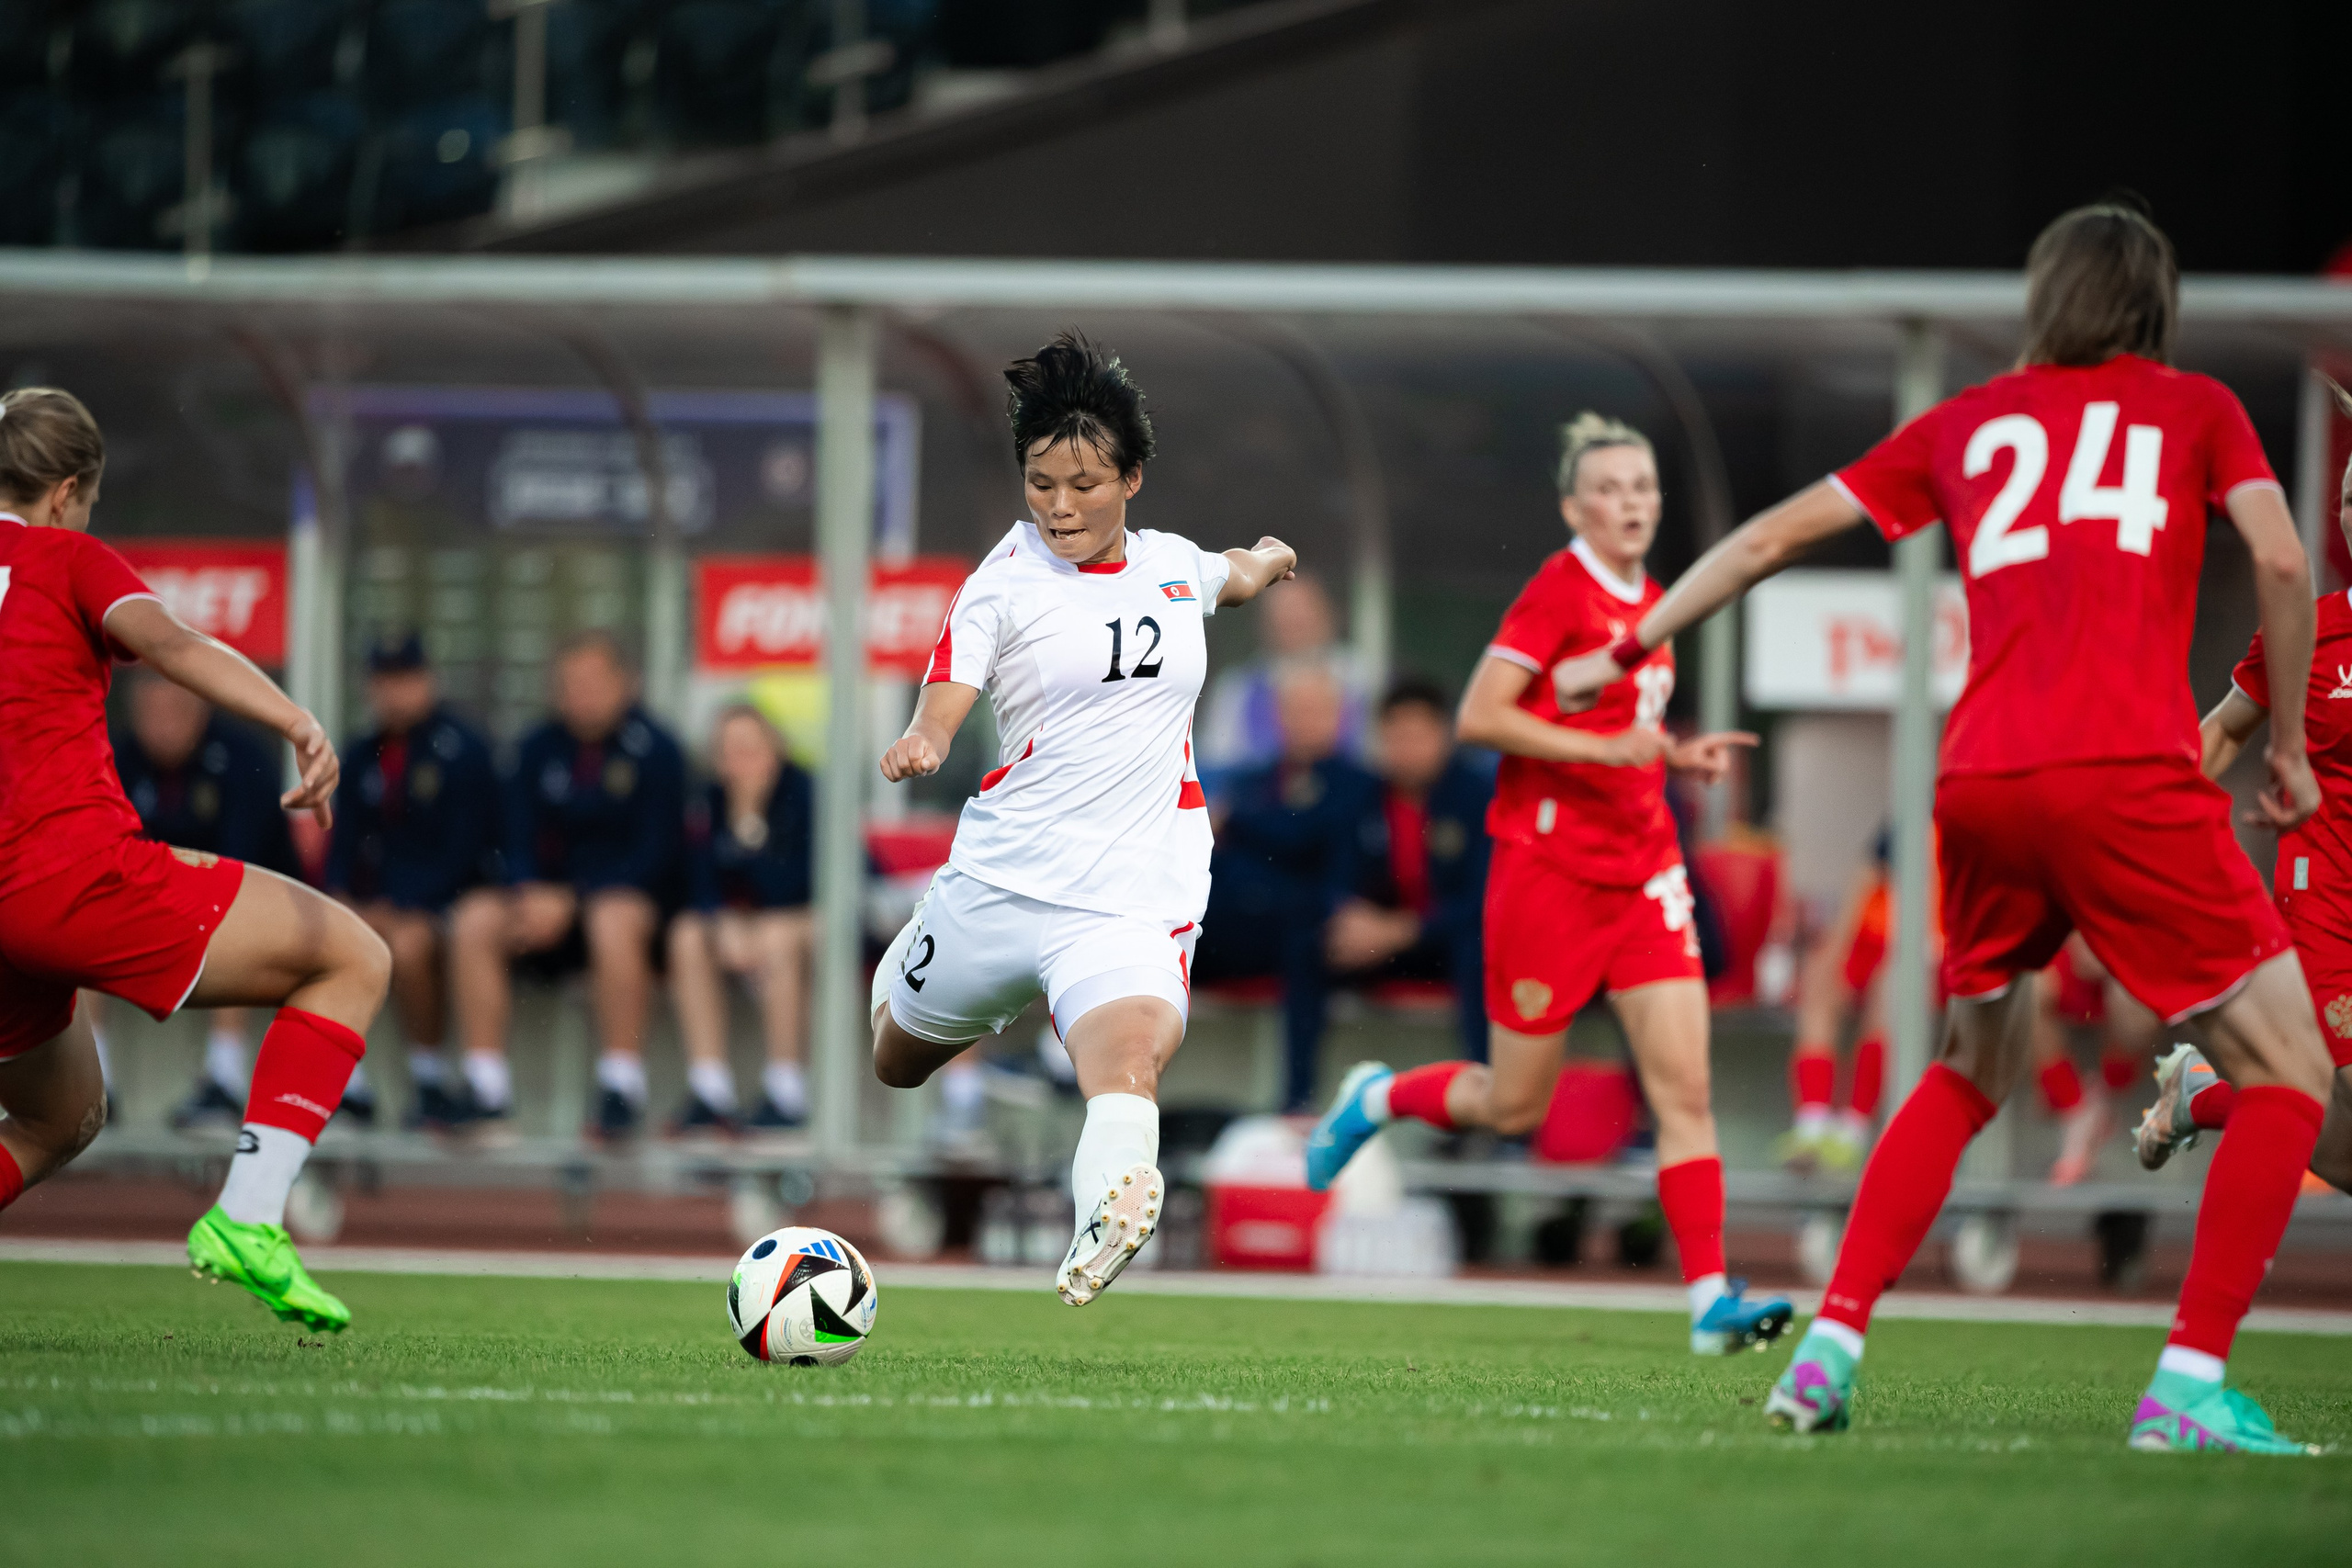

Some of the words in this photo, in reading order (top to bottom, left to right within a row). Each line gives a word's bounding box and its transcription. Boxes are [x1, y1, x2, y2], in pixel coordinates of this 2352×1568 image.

[1962, 400, 2169, 580] 24
[141, 568, 269, 636] BET
[1102, 615, 1164, 682] 12
[901, 923, 935, 993] 2
